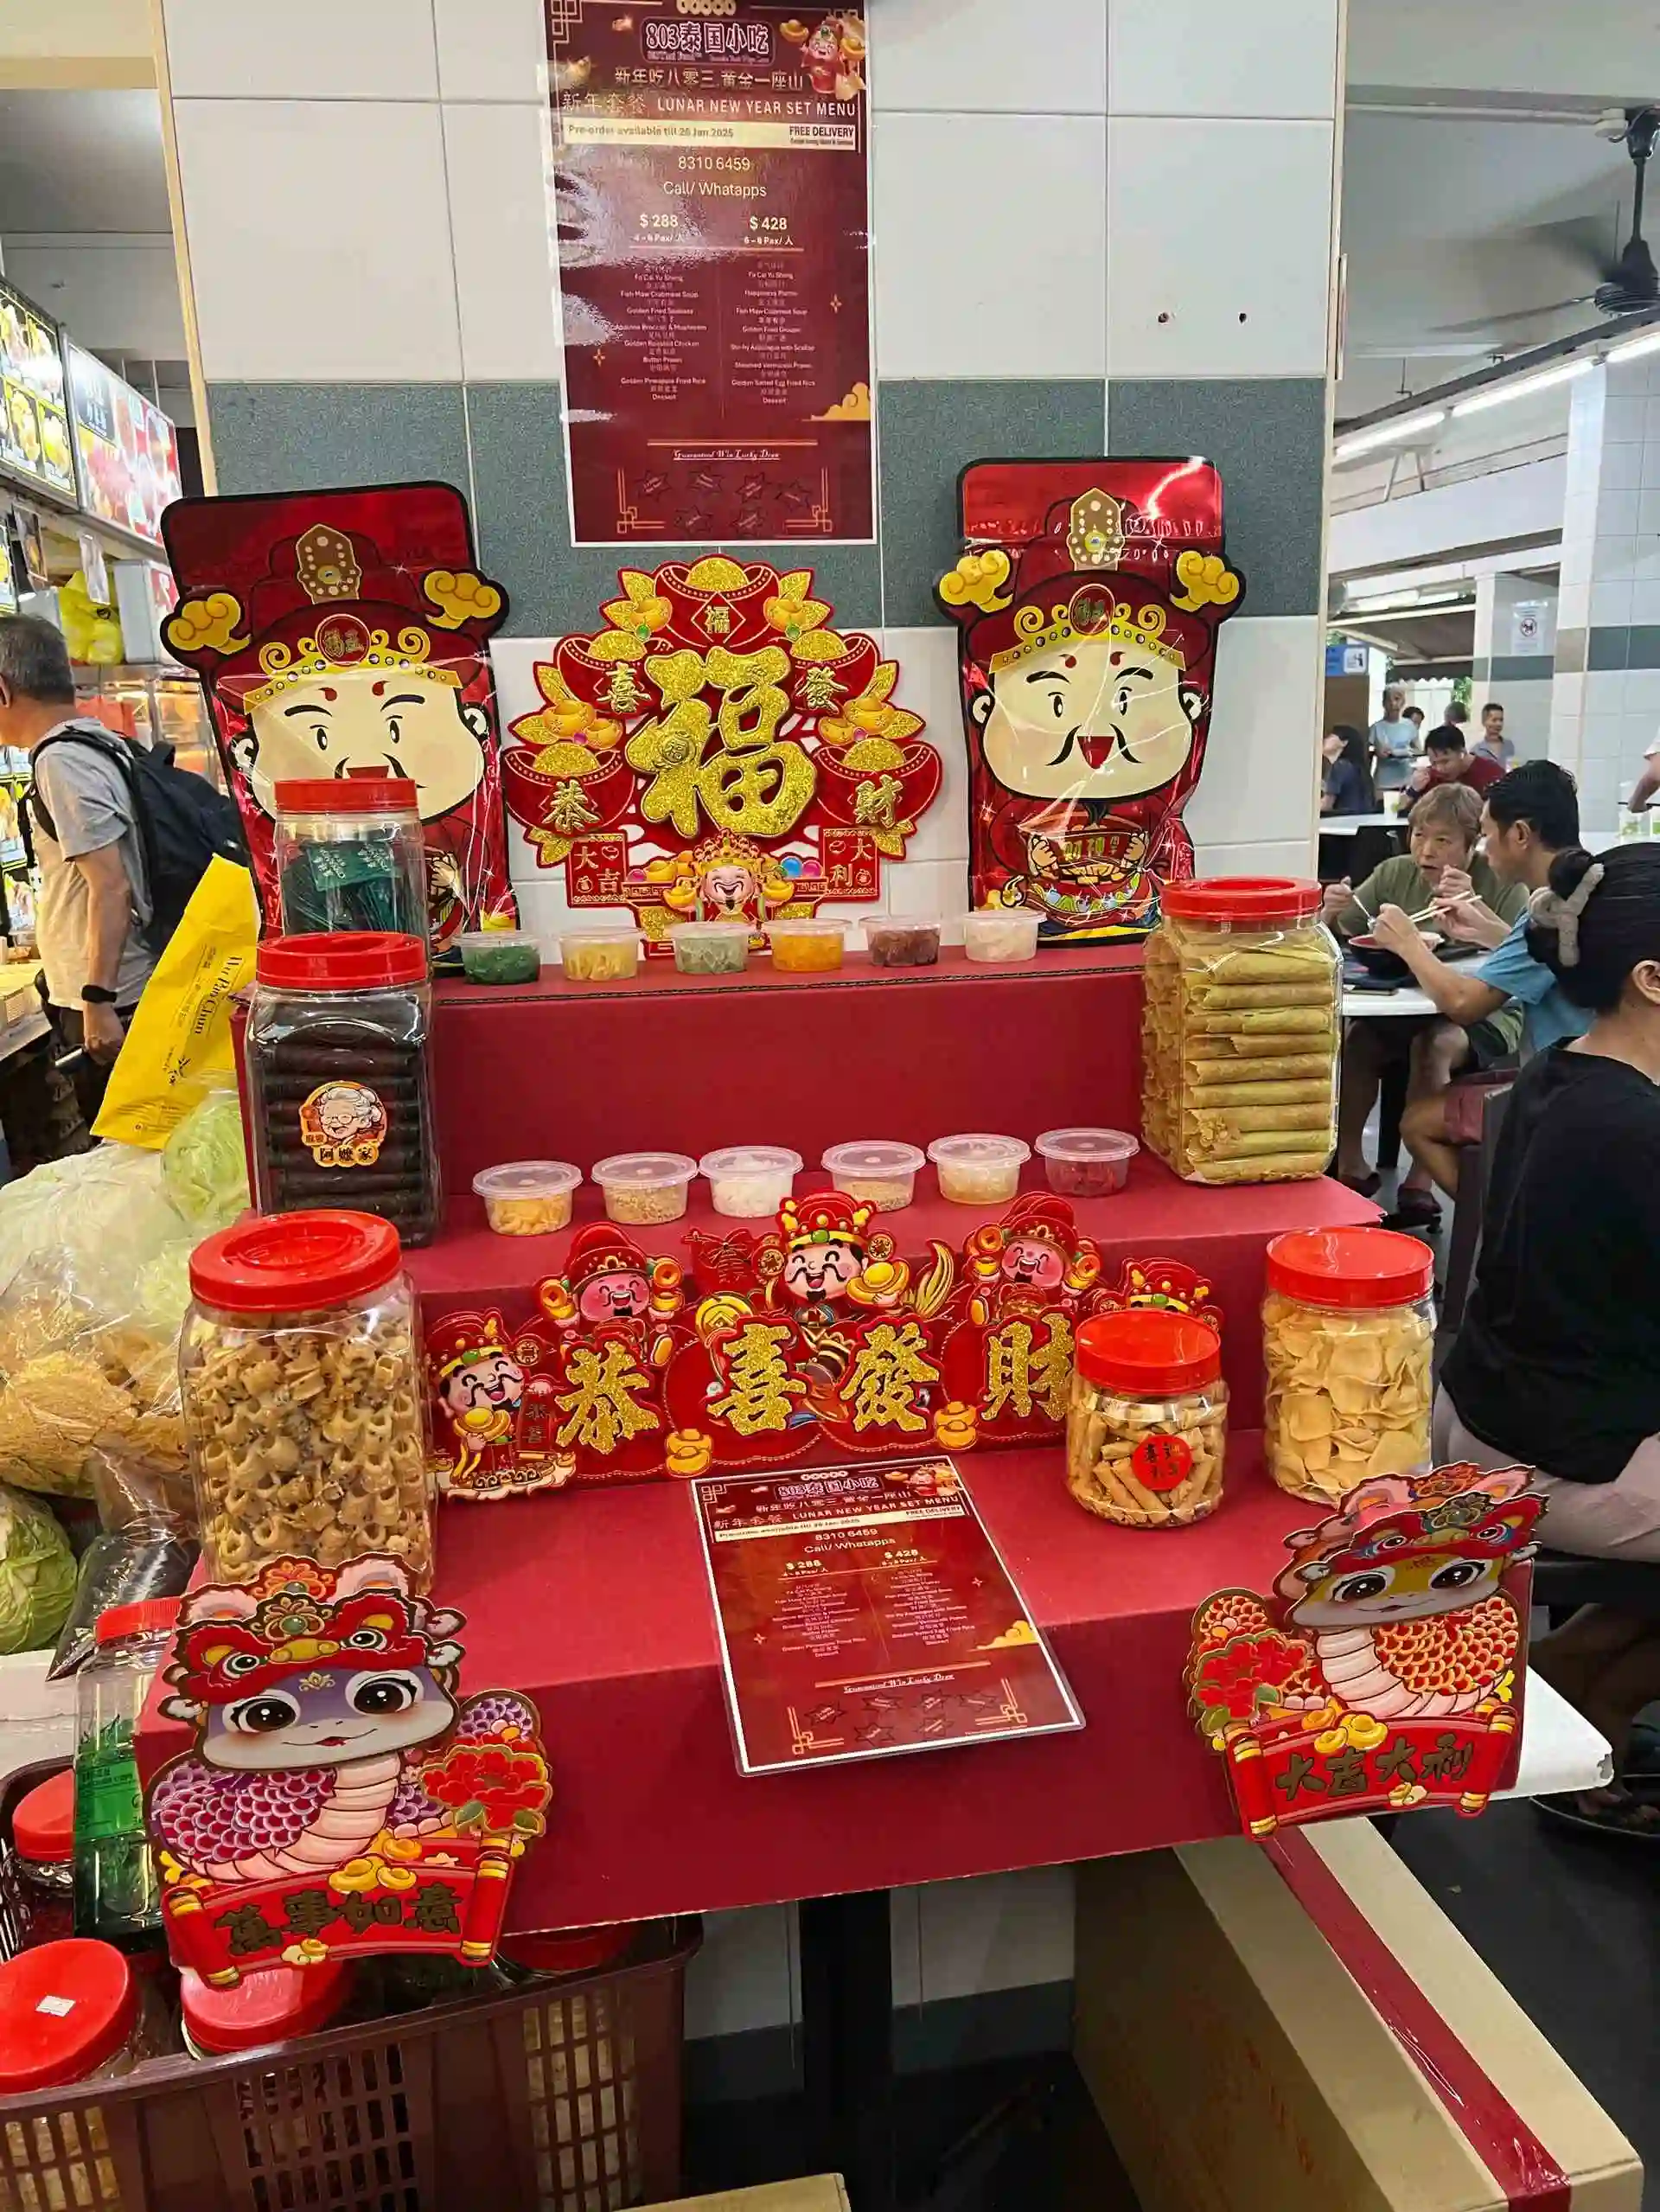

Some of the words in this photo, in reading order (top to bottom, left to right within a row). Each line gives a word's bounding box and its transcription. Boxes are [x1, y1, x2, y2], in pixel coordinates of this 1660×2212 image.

[646, 21, 769, 54] 803泰国小吃
[562, 92, 647, 114] 新年套餐
[657, 96, 705, 112] LUNAR
[709, 99, 740, 113] NEW
[746, 100, 781, 114] YEAR
[787, 102, 811, 115] SET
[817, 103, 855, 116] MENU
[568, 125, 614, 136] Pre-order
[617, 125, 661, 136] available
[711, 128, 734, 138] 2025
[789, 125, 810, 137] FREE
[813, 126, 854, 138] DELIVERY
[679, 156, 713, 171] 8310
[716, 157, 750, 172] 6459
[663, 181, 696, 196] Call/
[699, 182, 767, 199] Whatapps
[653, 214, 679, 228] 288
[762, 217, 788, 231] 428
[705, 605, 730, 634] 福
[597, 662, 652, 715] 喜
[626, 645, 818, 839] 福
[541, 779, 601, 833] 恭
[852, 775, 904, 830] 財
[792, 1510, 833, 1520] LUNAR
[836, 1506, 862, 1515] NEW
[865, 1502, 897, 1512] YEAR
[925, 1496, 959, 1506] MENU
[1274, 1733, 1475, 1801] 大吉大利
[216, 1882, 463, 1956] 萬事如意
